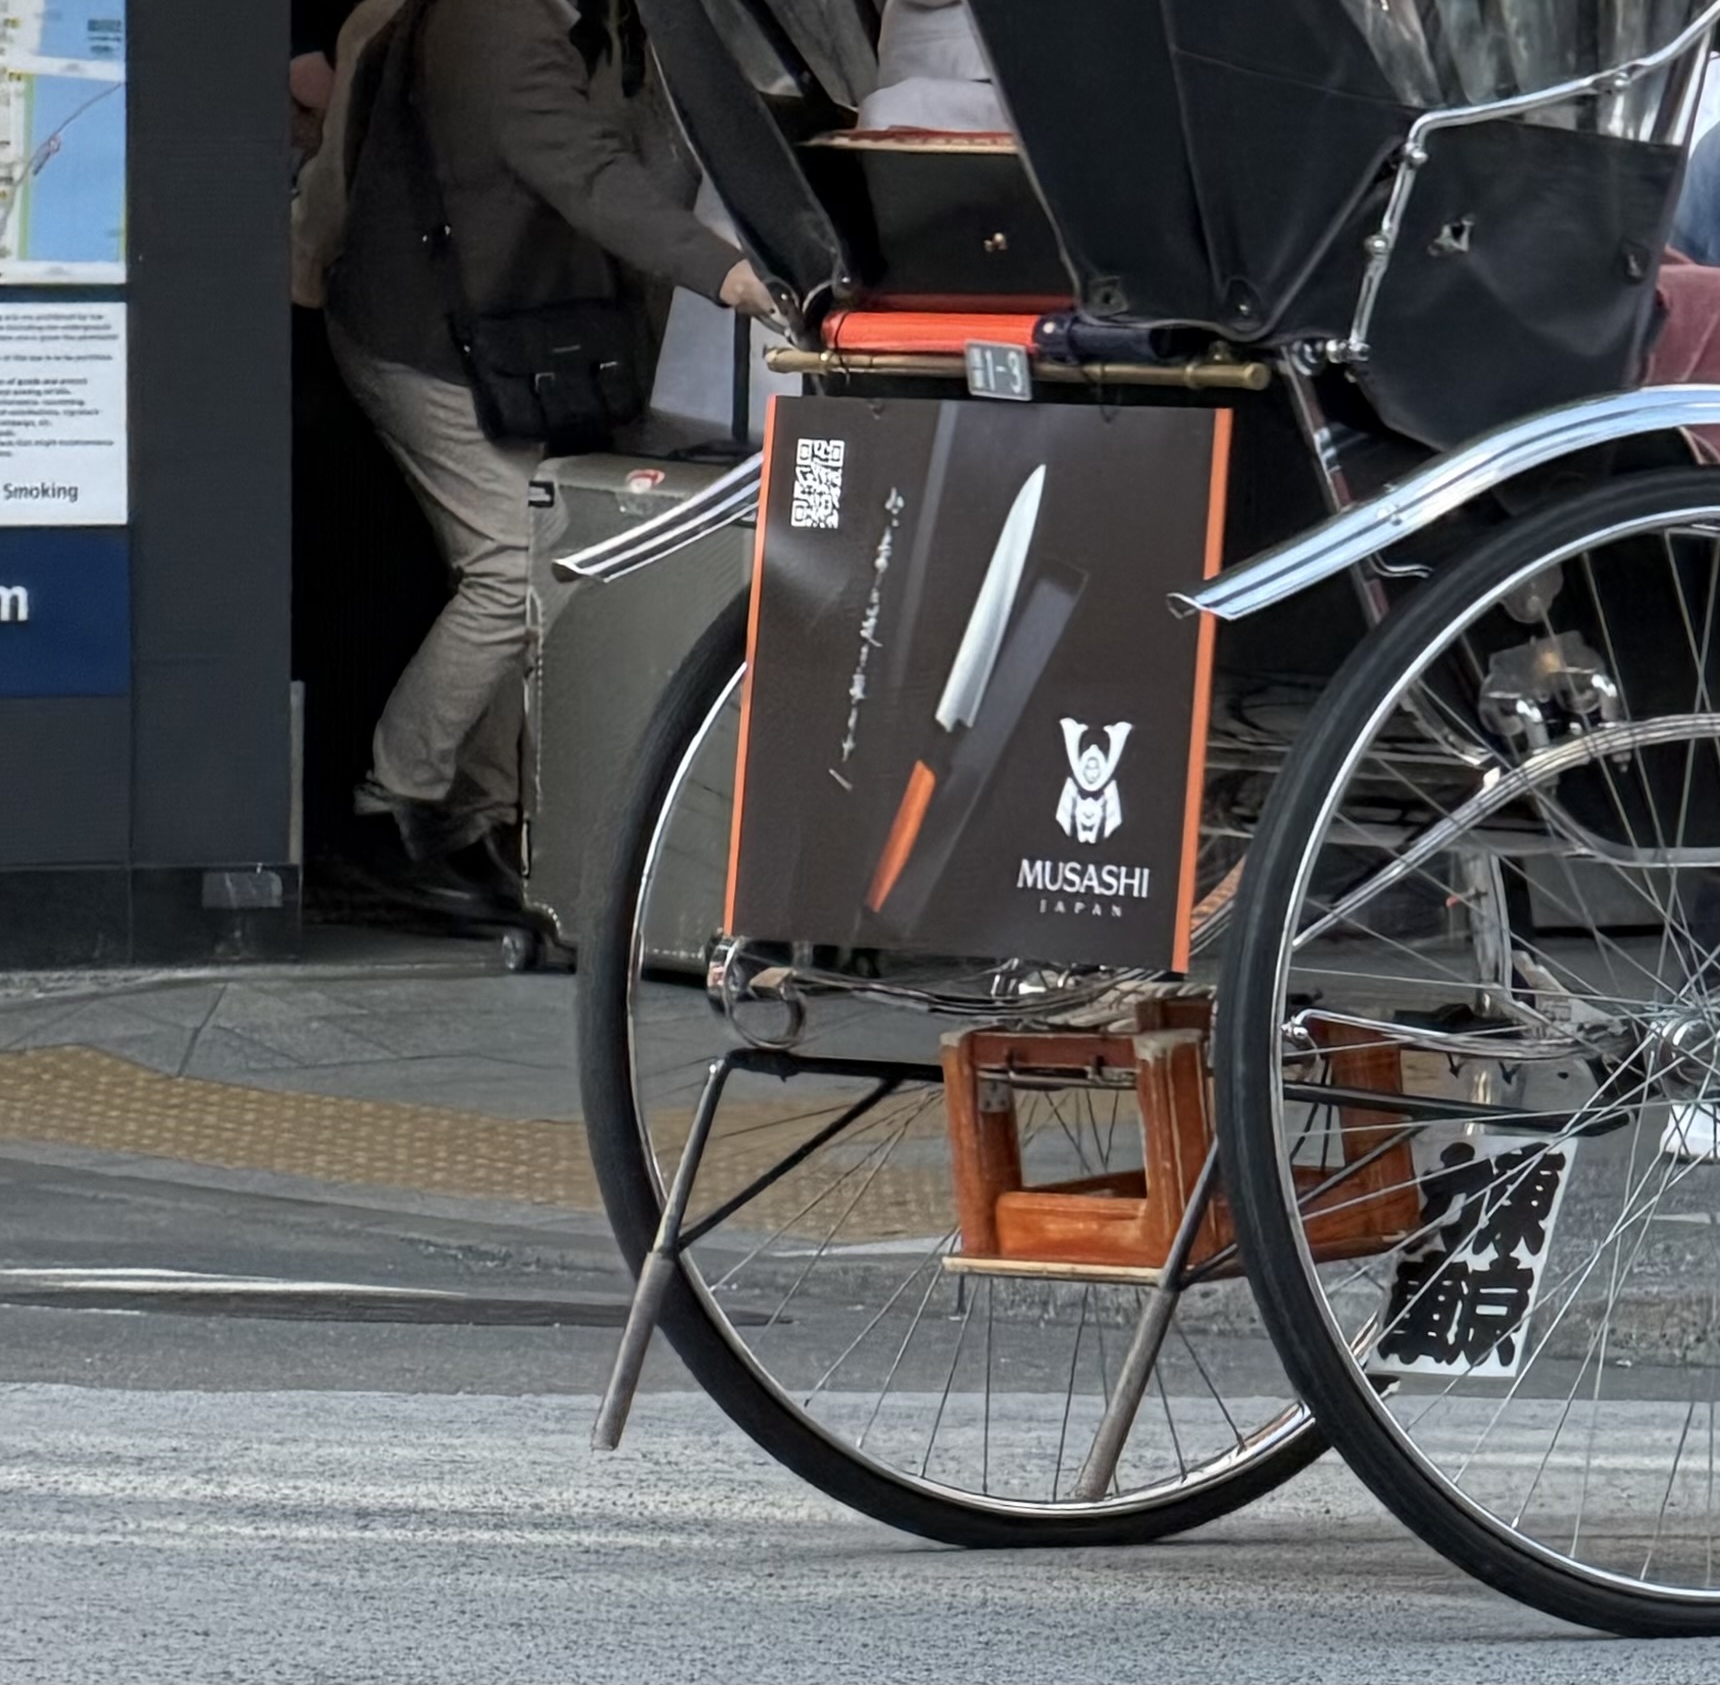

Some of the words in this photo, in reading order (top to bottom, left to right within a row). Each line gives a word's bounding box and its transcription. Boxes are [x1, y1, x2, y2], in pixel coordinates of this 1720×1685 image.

[3, 481, 79, 504] Smoking
[1016, 857, 1151, 898] MUSASHI
[1039, 898, 1122, 918] JAPAN
